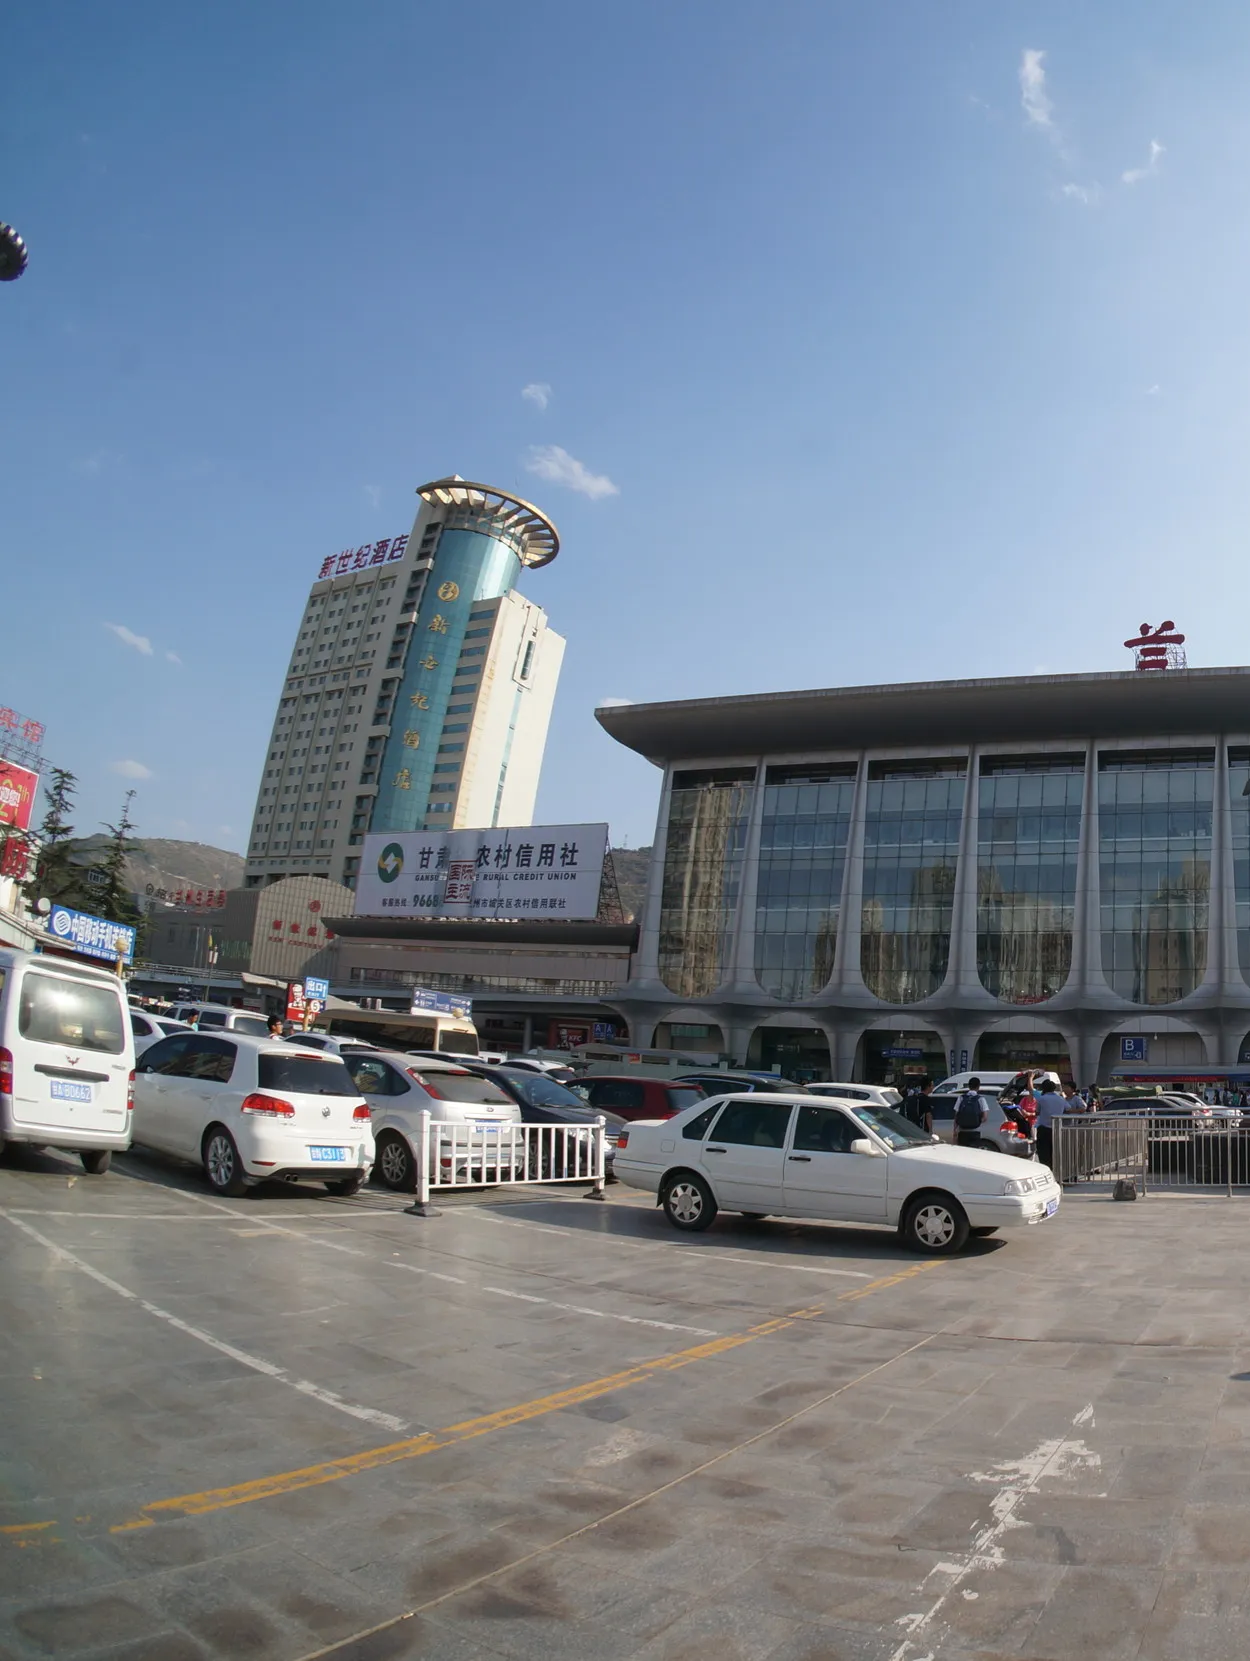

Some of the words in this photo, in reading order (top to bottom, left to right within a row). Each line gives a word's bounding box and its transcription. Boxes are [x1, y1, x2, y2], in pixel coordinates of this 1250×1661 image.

[318, 533, 409, 579] 新世纪酒店
[392, 613, 449, 791] 新世纪酒店
[547, 872, 577, 880] UNION
[470, 898, 567, 908] 州市城关区农村信用联社
[1125, 1039, 1134, 1051] B
